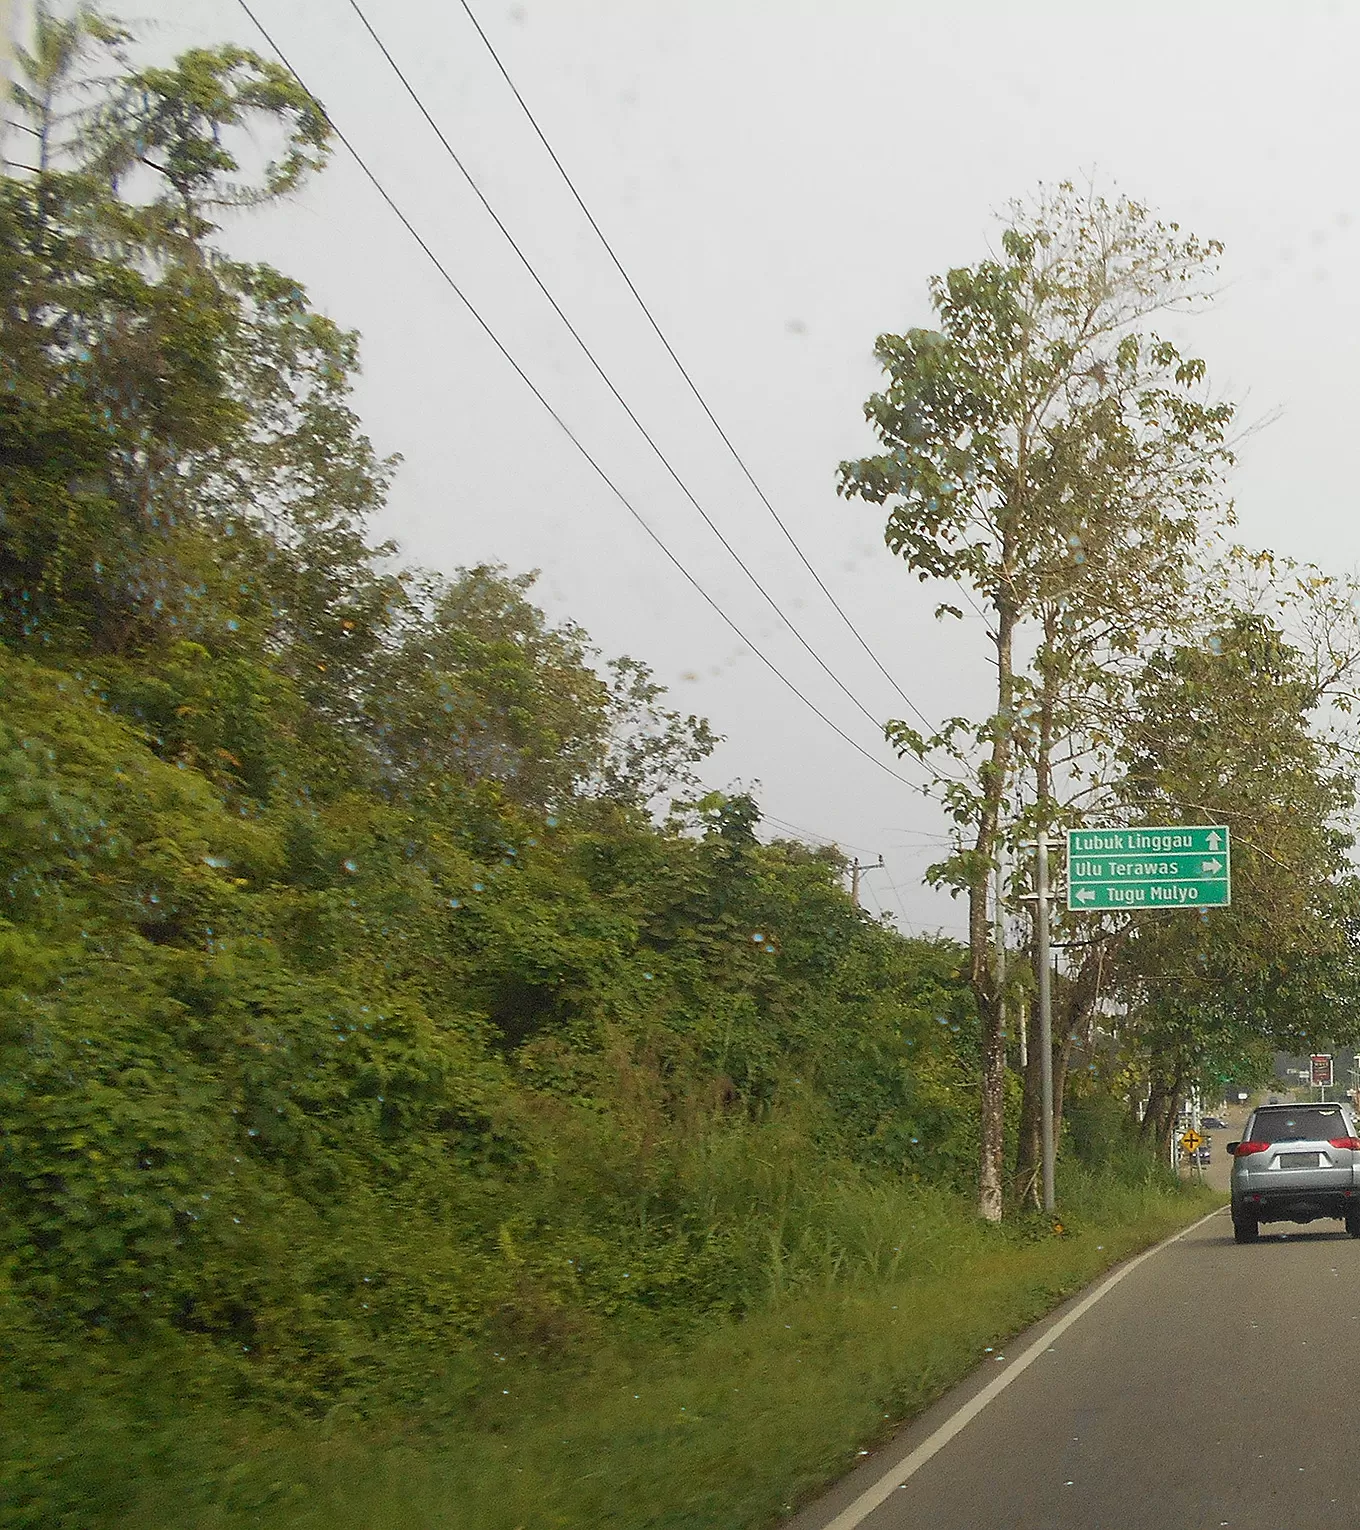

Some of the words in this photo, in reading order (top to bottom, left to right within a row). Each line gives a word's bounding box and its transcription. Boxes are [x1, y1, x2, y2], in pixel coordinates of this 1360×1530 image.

[1076, 835, 1123, 850] Lubuk
[1128, 834, 1192, 851] Linggau
[1076, 862, 1102, 876] Ulu
[1109, 862, 1178, 876] Terawas
[1107, 888, 1145, 904] Tugu
[1151, 886, 1198, 903] Mulyo
